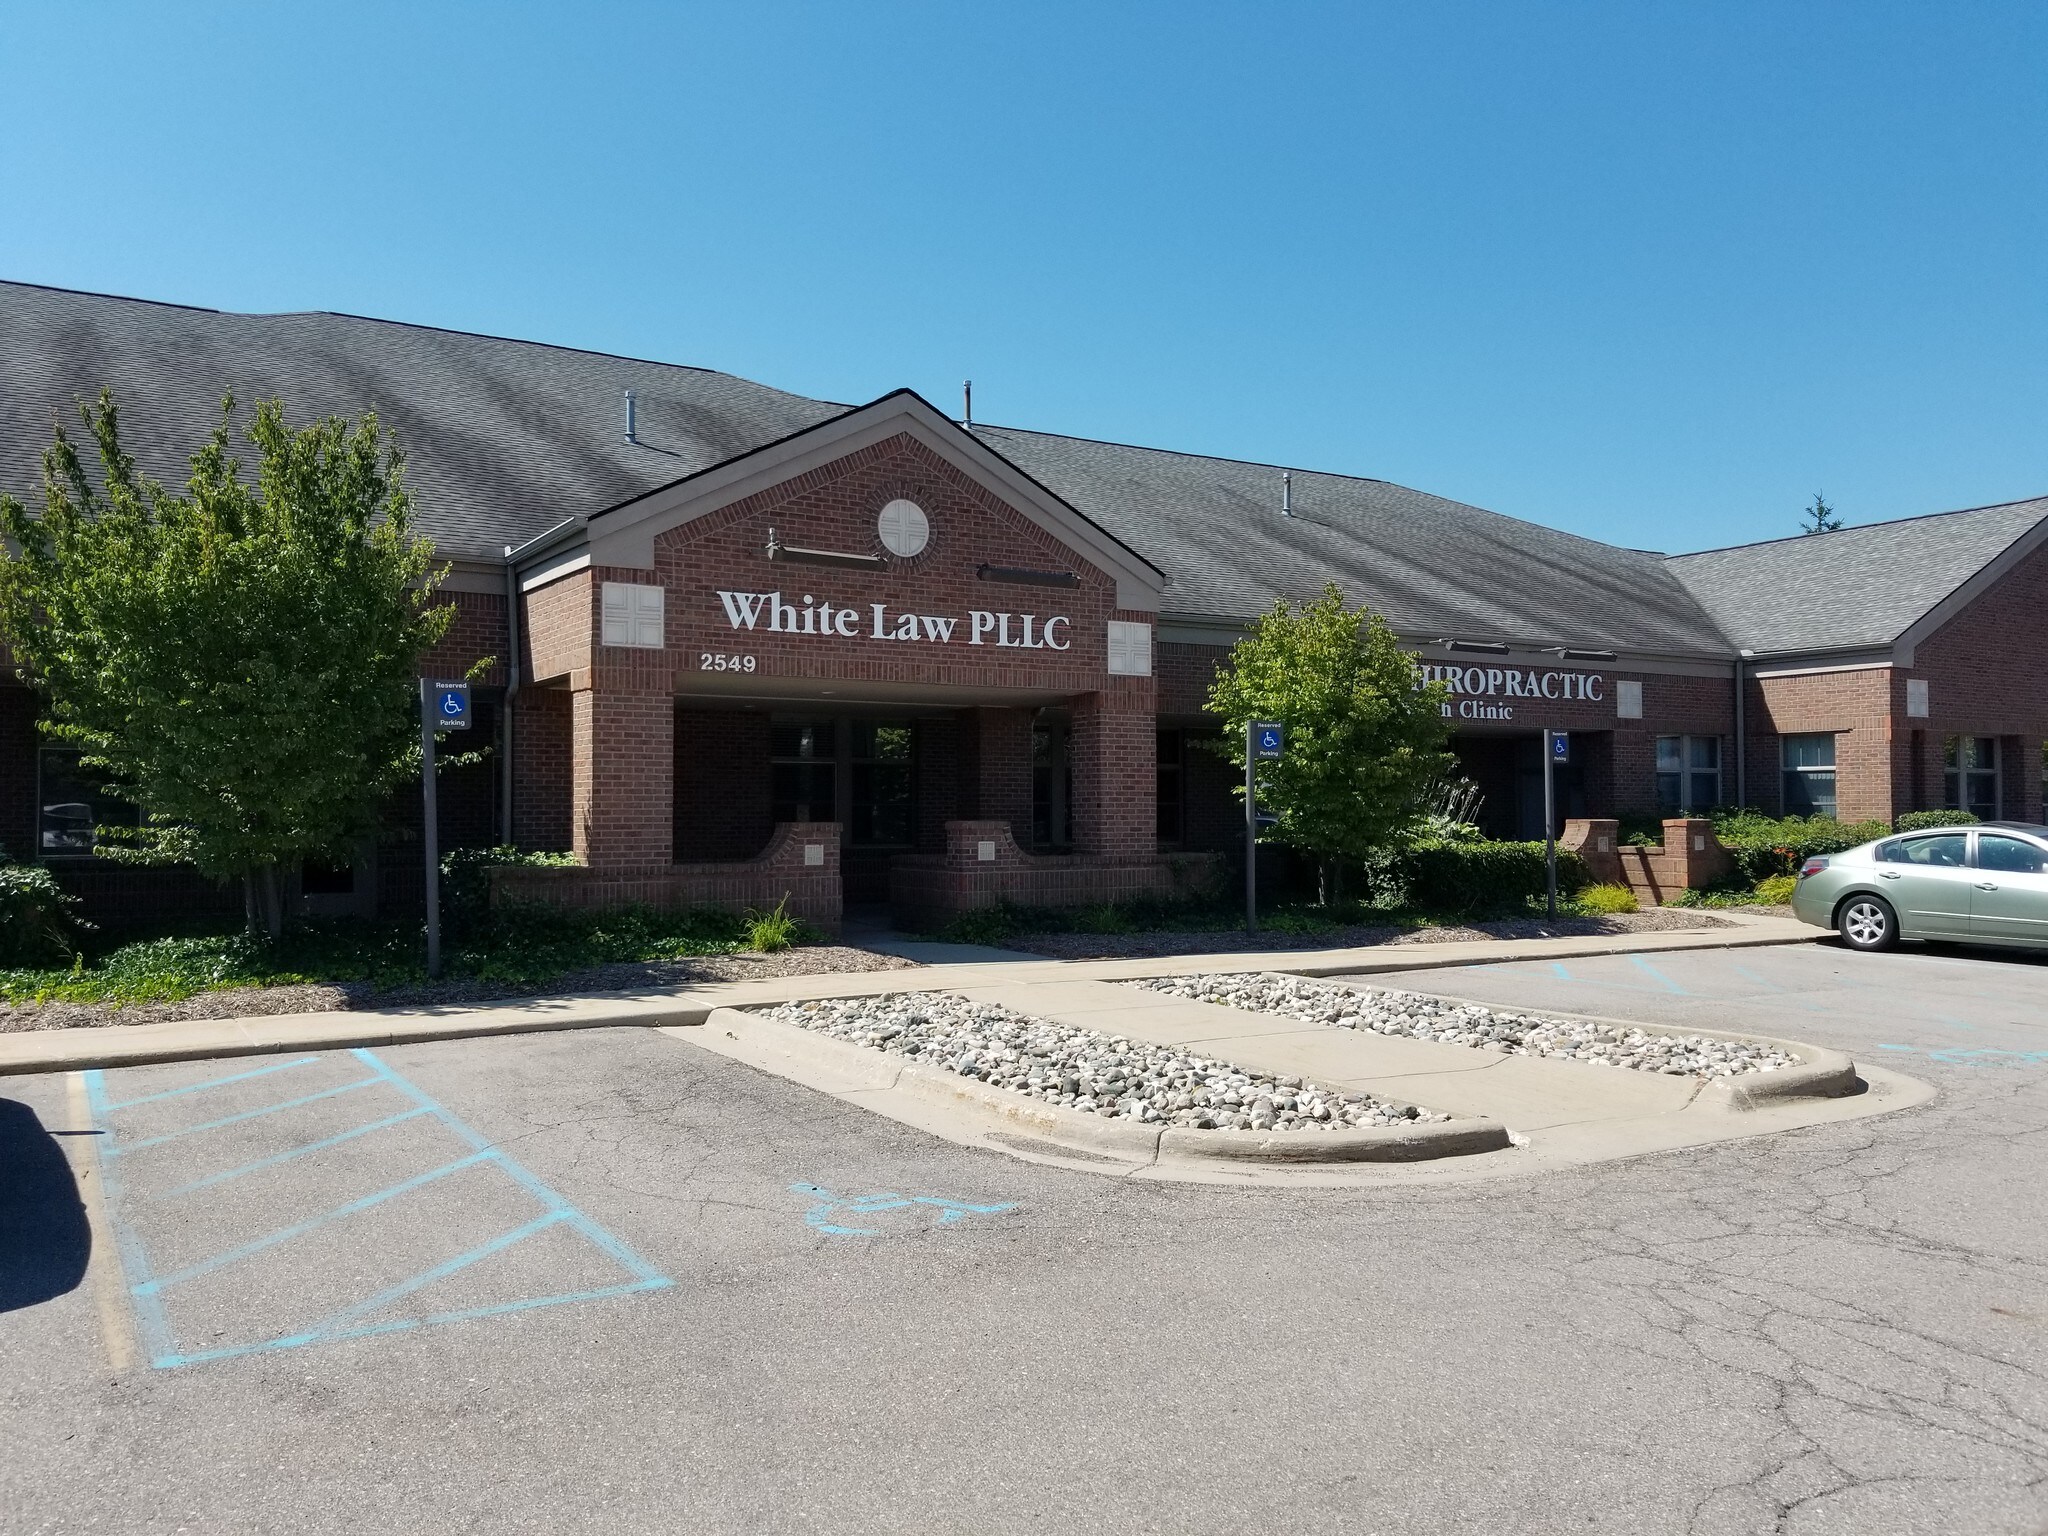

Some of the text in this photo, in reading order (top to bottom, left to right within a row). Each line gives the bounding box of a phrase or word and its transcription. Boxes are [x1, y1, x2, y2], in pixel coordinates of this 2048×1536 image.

[716, 590, 1071, 650] White Law PLLC
[700, 653, 756, 673] 2549
[1411, 664, 1603, 701] HIROPRACTIC
[1459, 700, 1513, 720] Clinic
[440, 719, 466, 727] Parking
